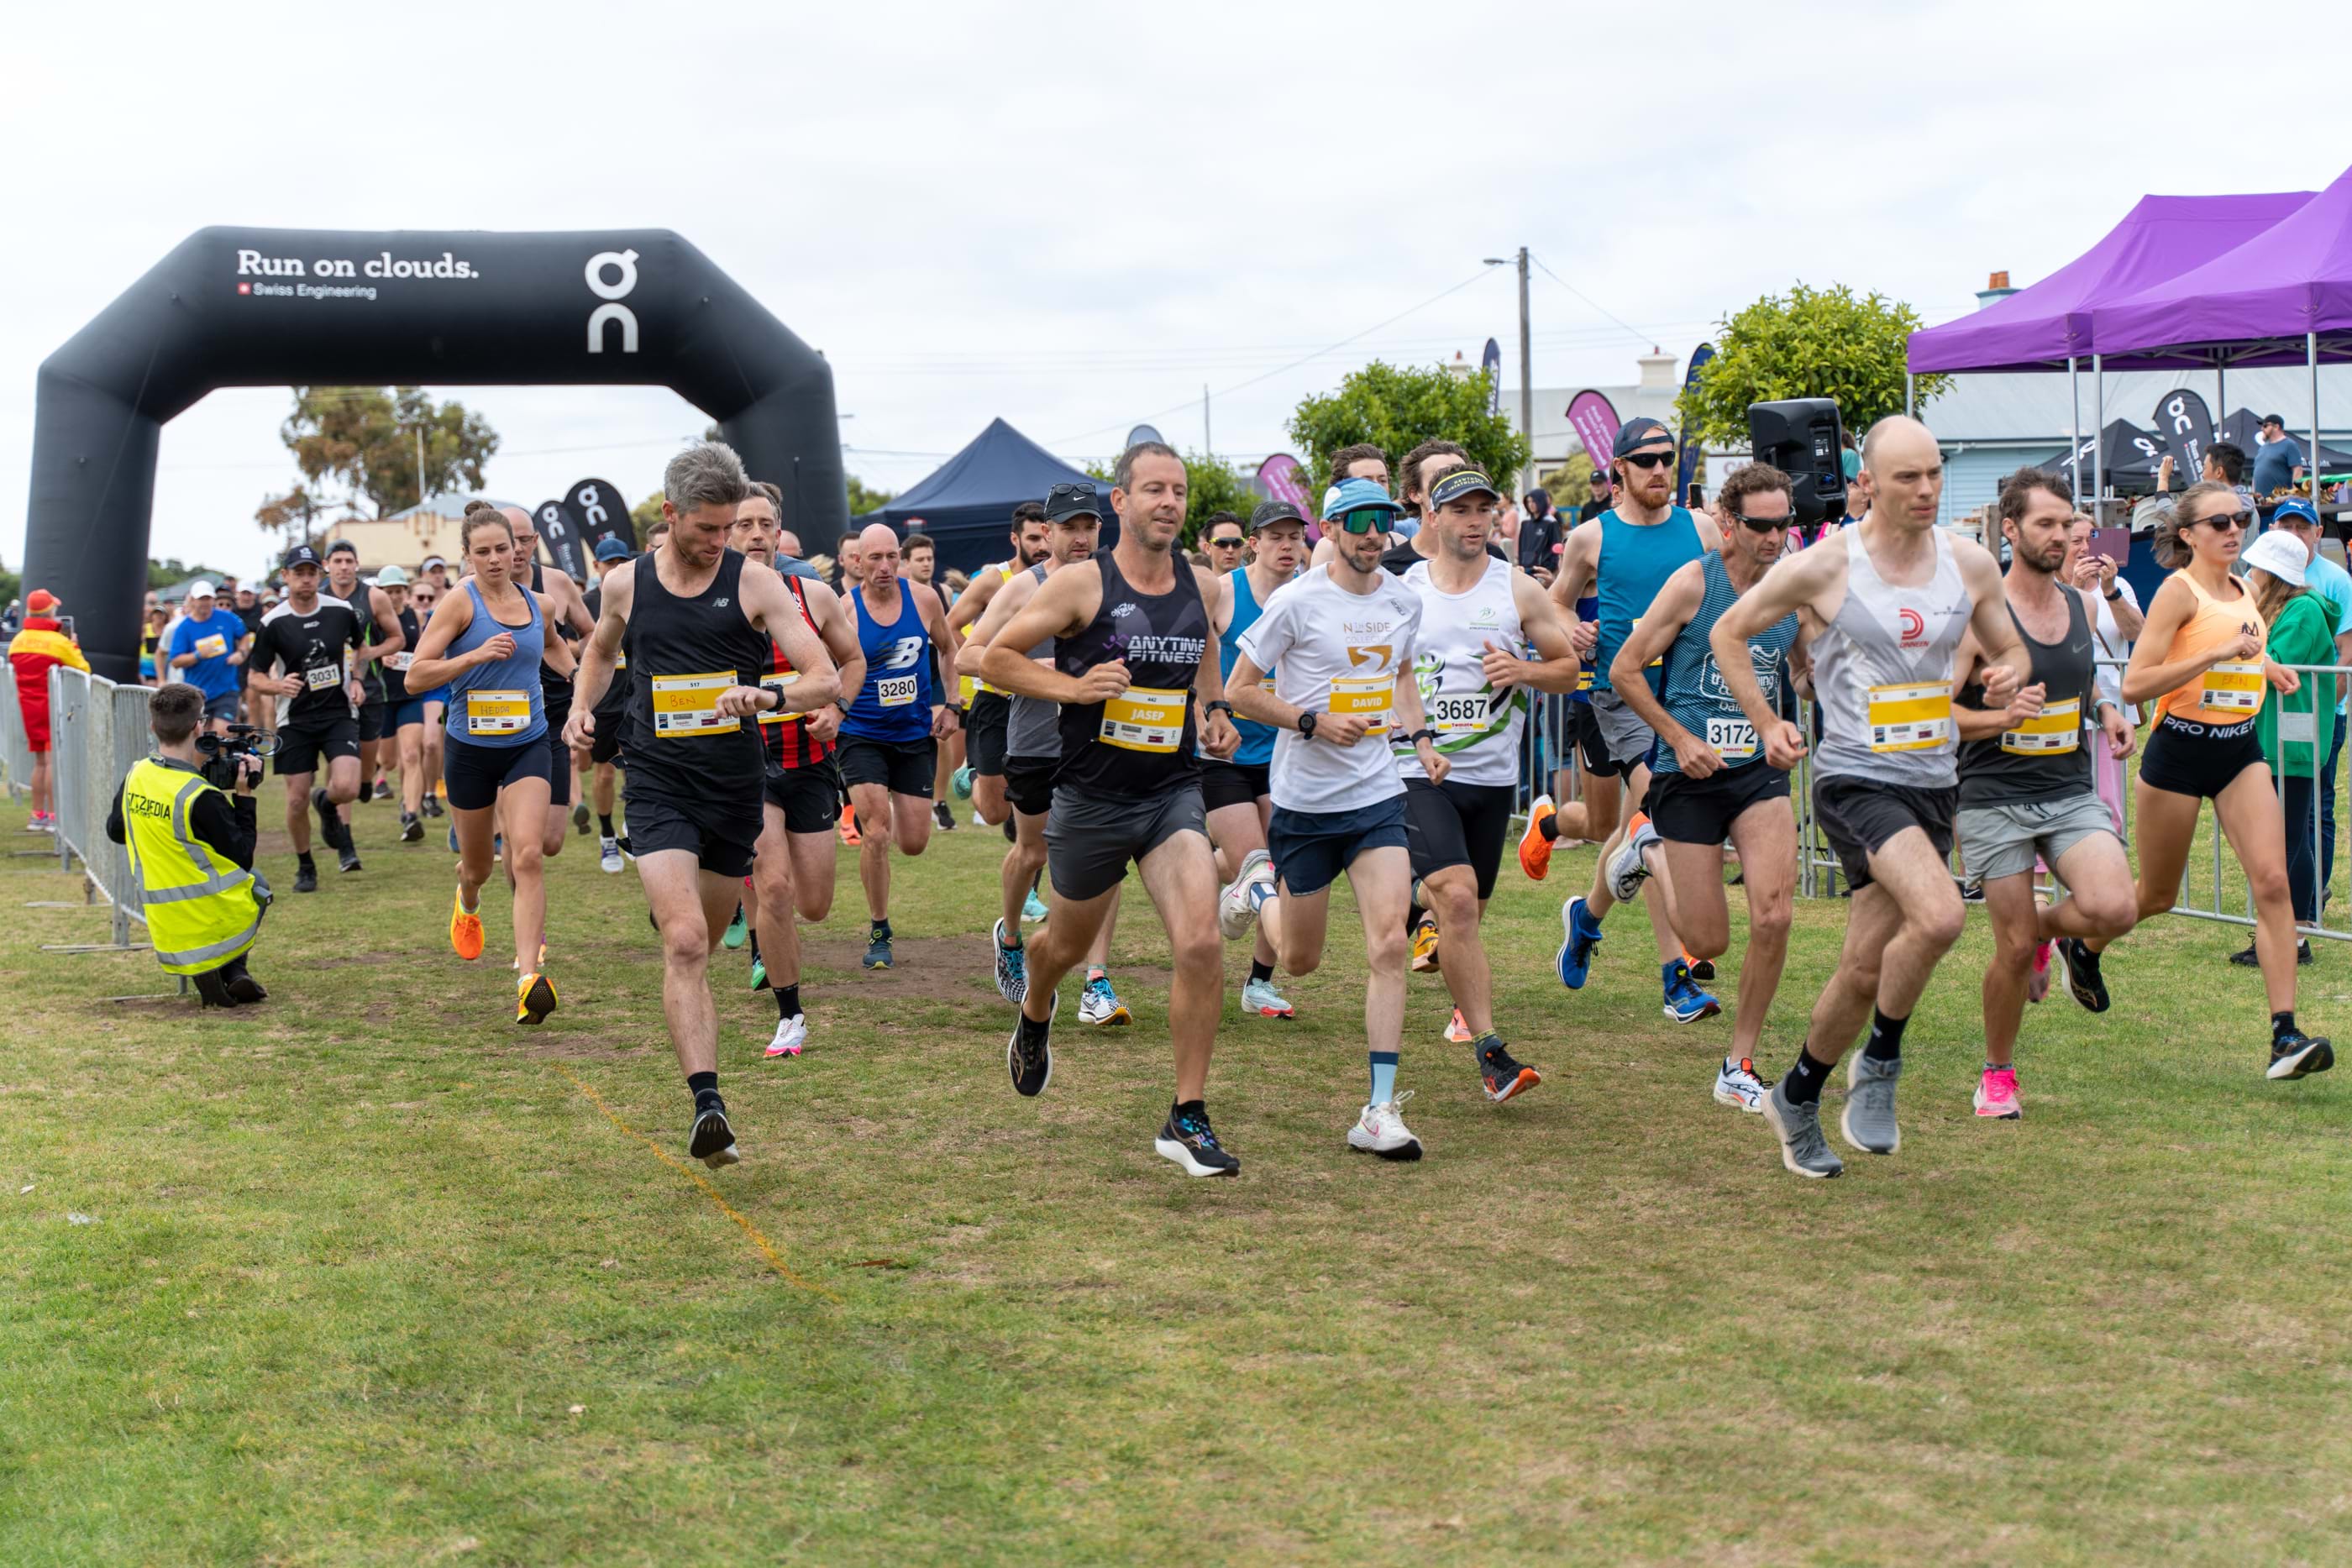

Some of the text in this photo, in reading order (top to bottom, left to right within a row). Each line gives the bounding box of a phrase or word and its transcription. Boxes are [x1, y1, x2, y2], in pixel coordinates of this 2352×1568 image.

[237, 249, 480, 279] Run on clouds.
[253, 282, 377, 301] Swiss Engineering
[1127, 635, 1205, 653] ANYTIME
[1345, 635, 1392, 645] COLLECTIVE
[1128, 650, 1203, 664] FITNESS
[310, 669, 337, 684] 3031
[880, 679, 916, 698] 3280
[669, 695, 696, 707] BEN
[1352, 697, 1383, 708] DAVID
[1436, 699, 1488, 721] 3687
[1130, 708, 1165, 721] JASEP
[1710, 724, 1756, 745] 3172
[2163, 716, 2204, 735] PRO
[2209, 724, 2250, 739] NIKE
